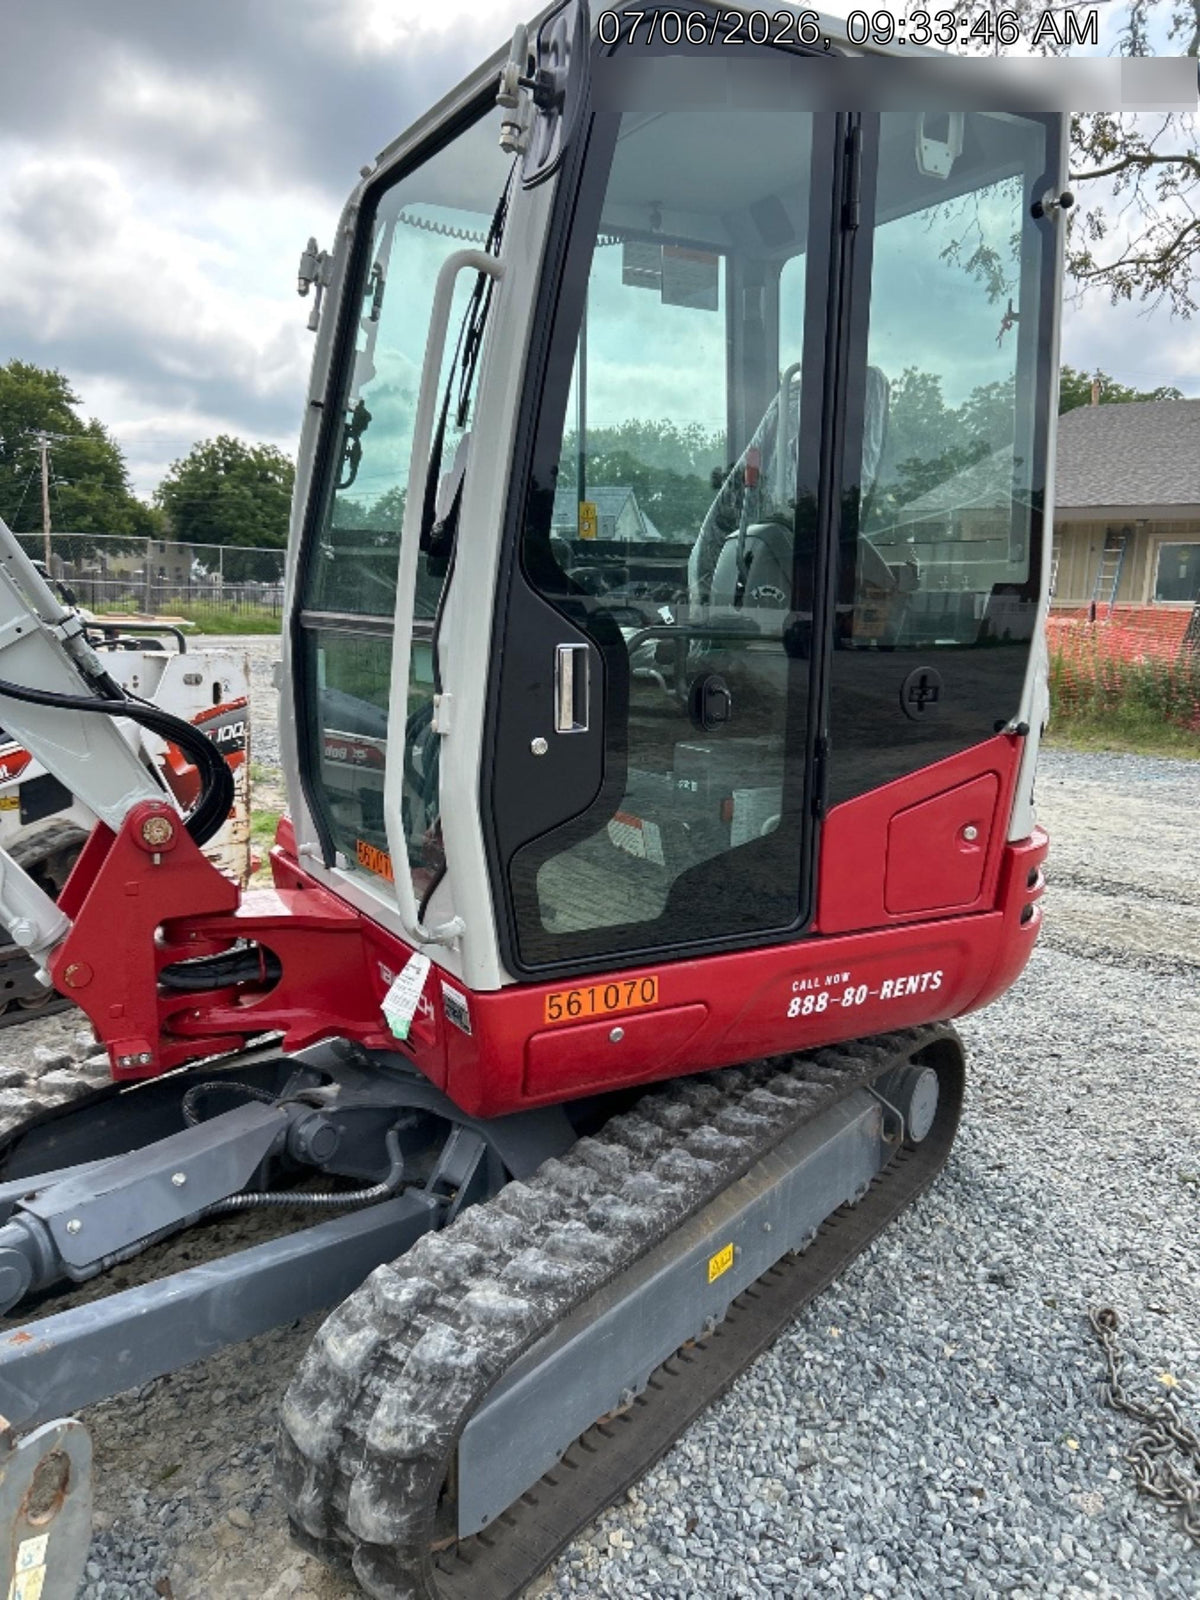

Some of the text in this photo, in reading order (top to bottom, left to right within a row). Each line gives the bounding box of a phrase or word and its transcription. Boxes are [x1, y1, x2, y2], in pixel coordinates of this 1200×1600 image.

[358, 842, 393, 879] 56107
[548, 978, 655, 1020] 561070
[787, 970, 943, 1018] 888-80-RENTS
[792, 972, 851, 992] CALL NOW
